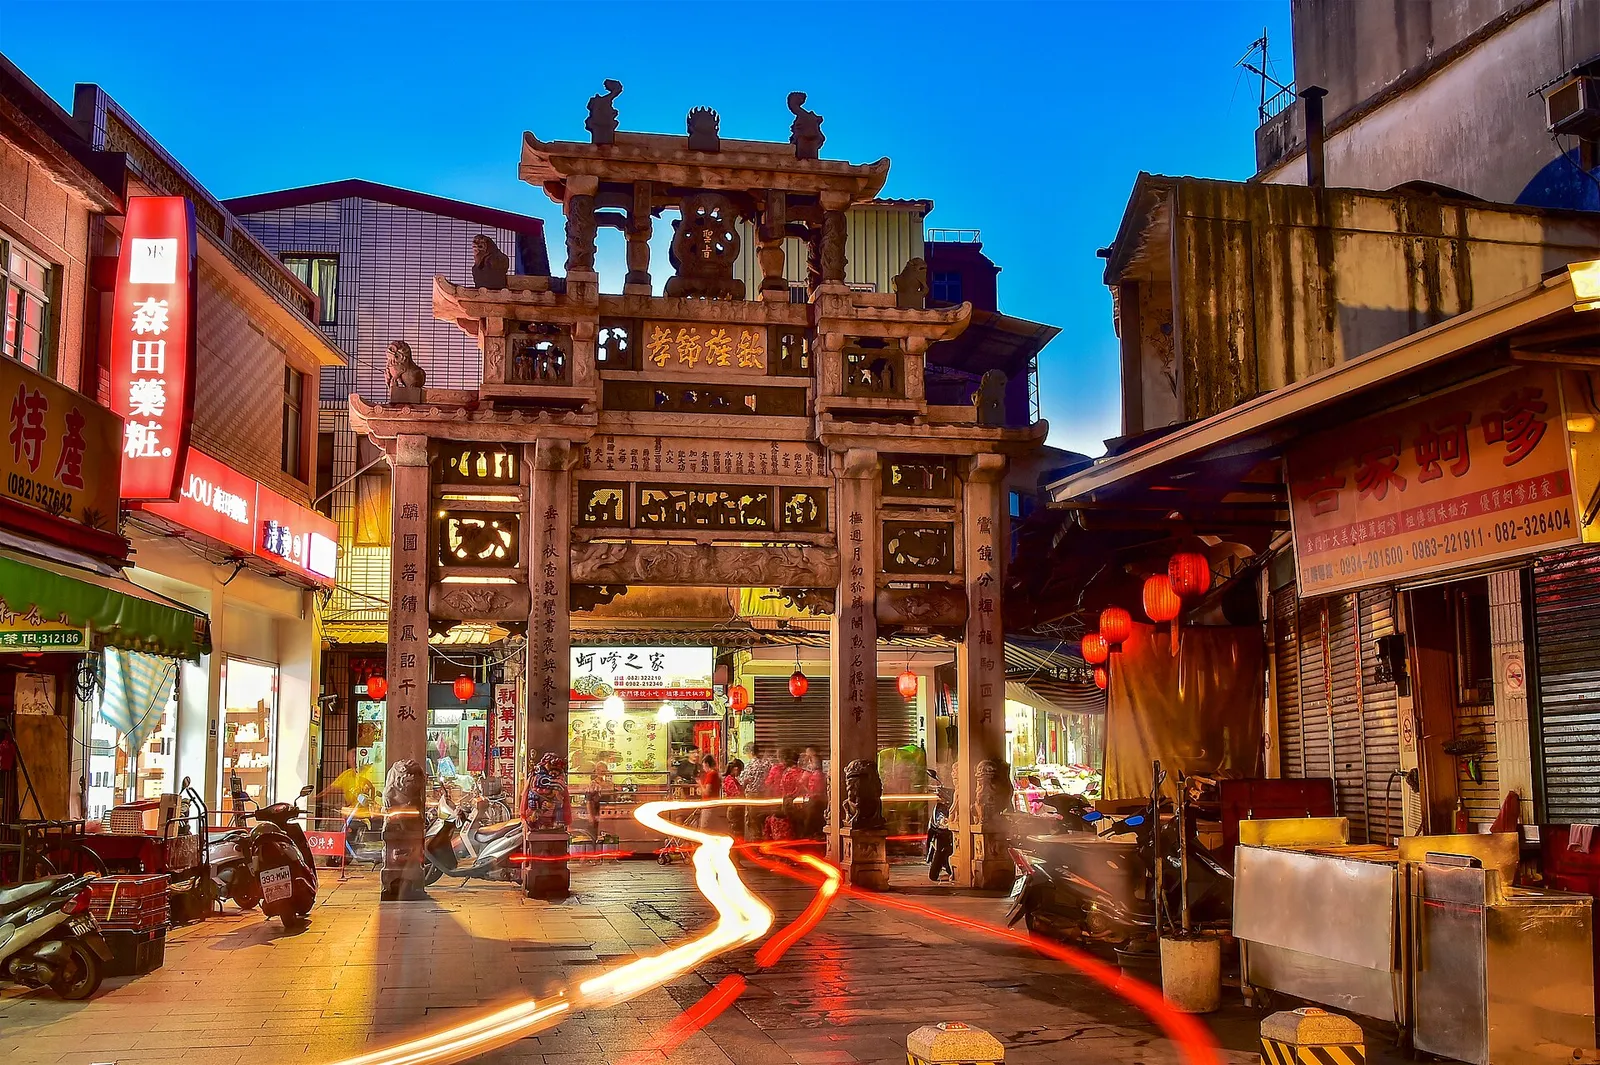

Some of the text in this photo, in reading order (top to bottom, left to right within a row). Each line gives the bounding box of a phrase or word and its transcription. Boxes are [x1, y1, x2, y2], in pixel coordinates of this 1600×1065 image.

[702, 229, 714, 259] 聖旨
[1412, 527, 1484, 560] 0963-221911
[1495, 507, 1571, 543] 082-326404
[0, 633, 18, 645] 茶
[575, 650, 665, 674] 蚵嗲之家
